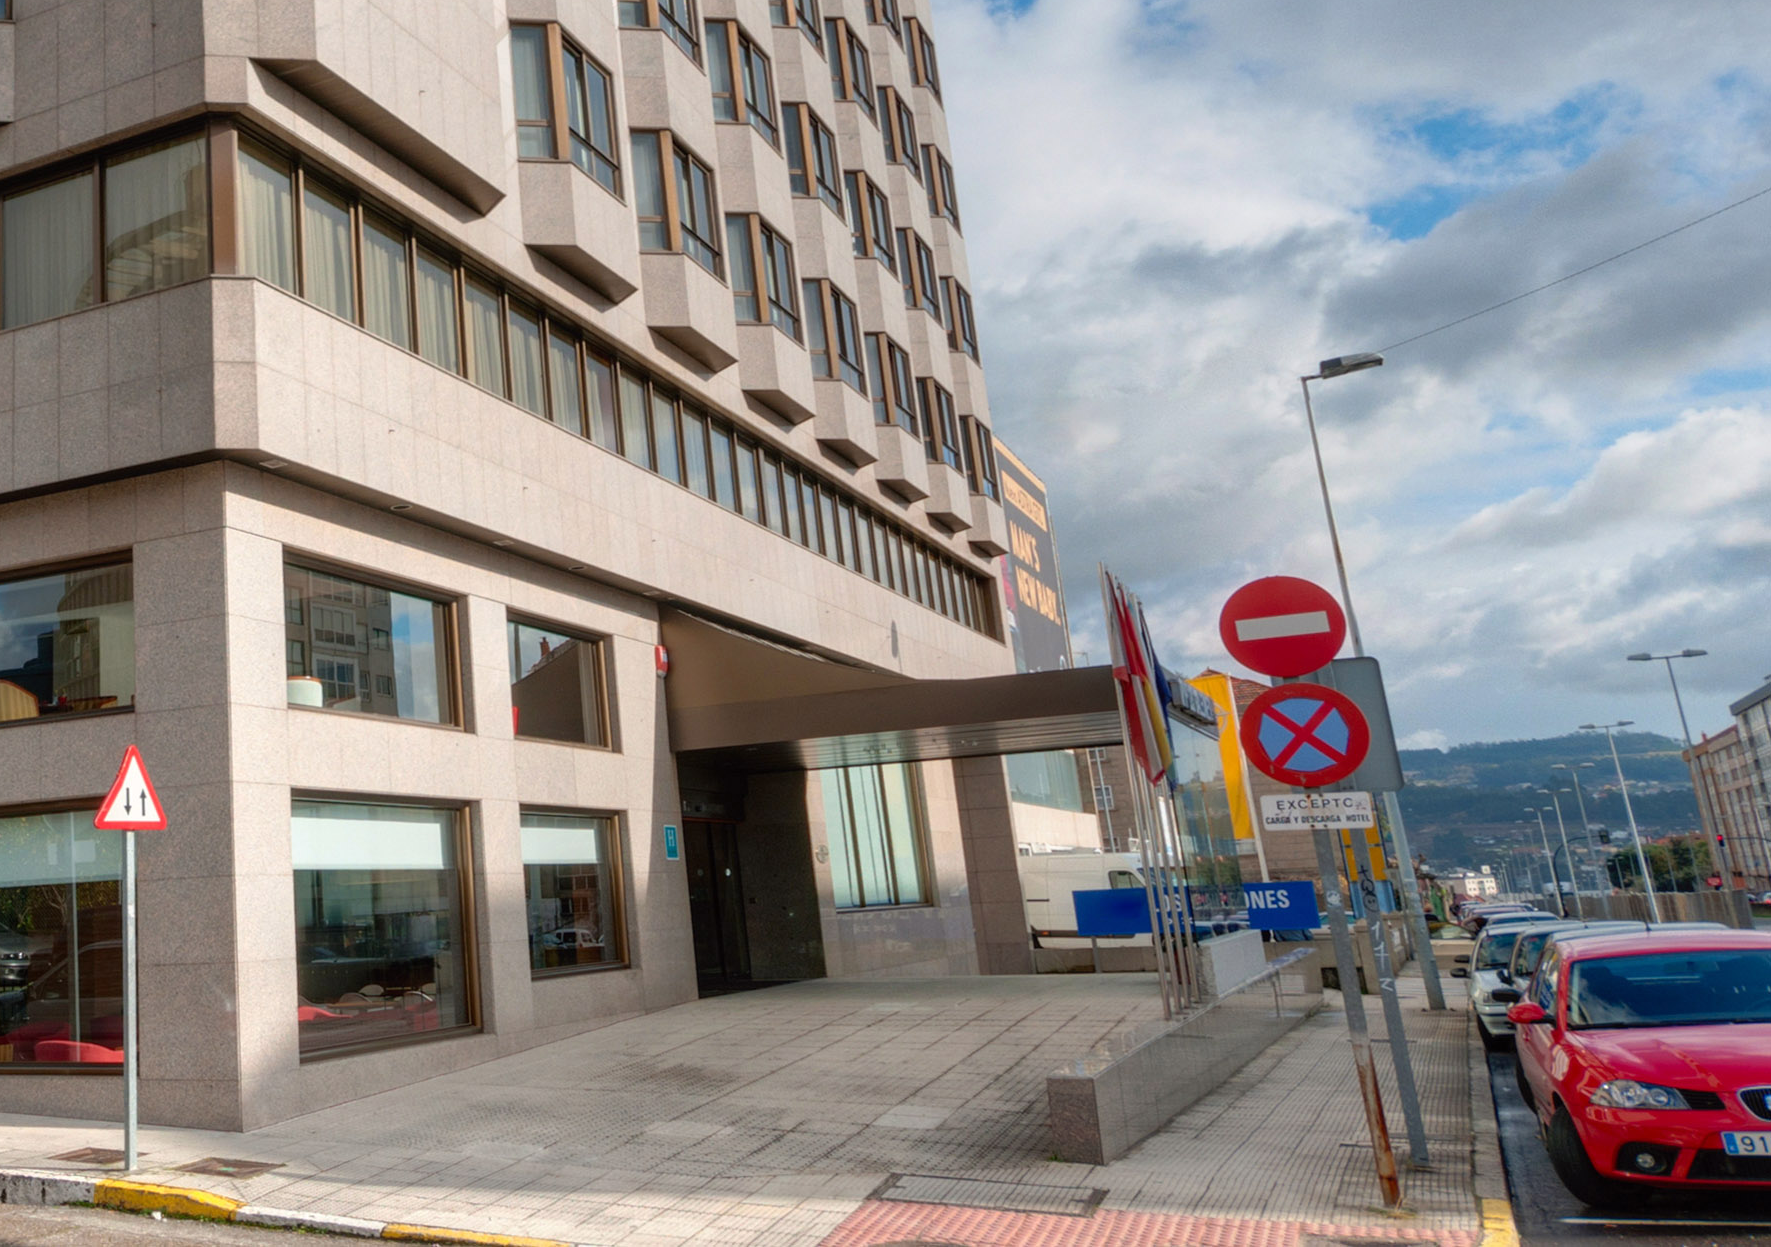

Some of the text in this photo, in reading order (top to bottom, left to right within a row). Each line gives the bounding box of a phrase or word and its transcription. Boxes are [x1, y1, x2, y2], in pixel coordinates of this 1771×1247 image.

[1009, 519, 1041, 573] MAN'S
[1015, 564, 1038, 611] NEW
[1265, 814, 1371, 825] CARGA Y DESCARGA HOTEL
